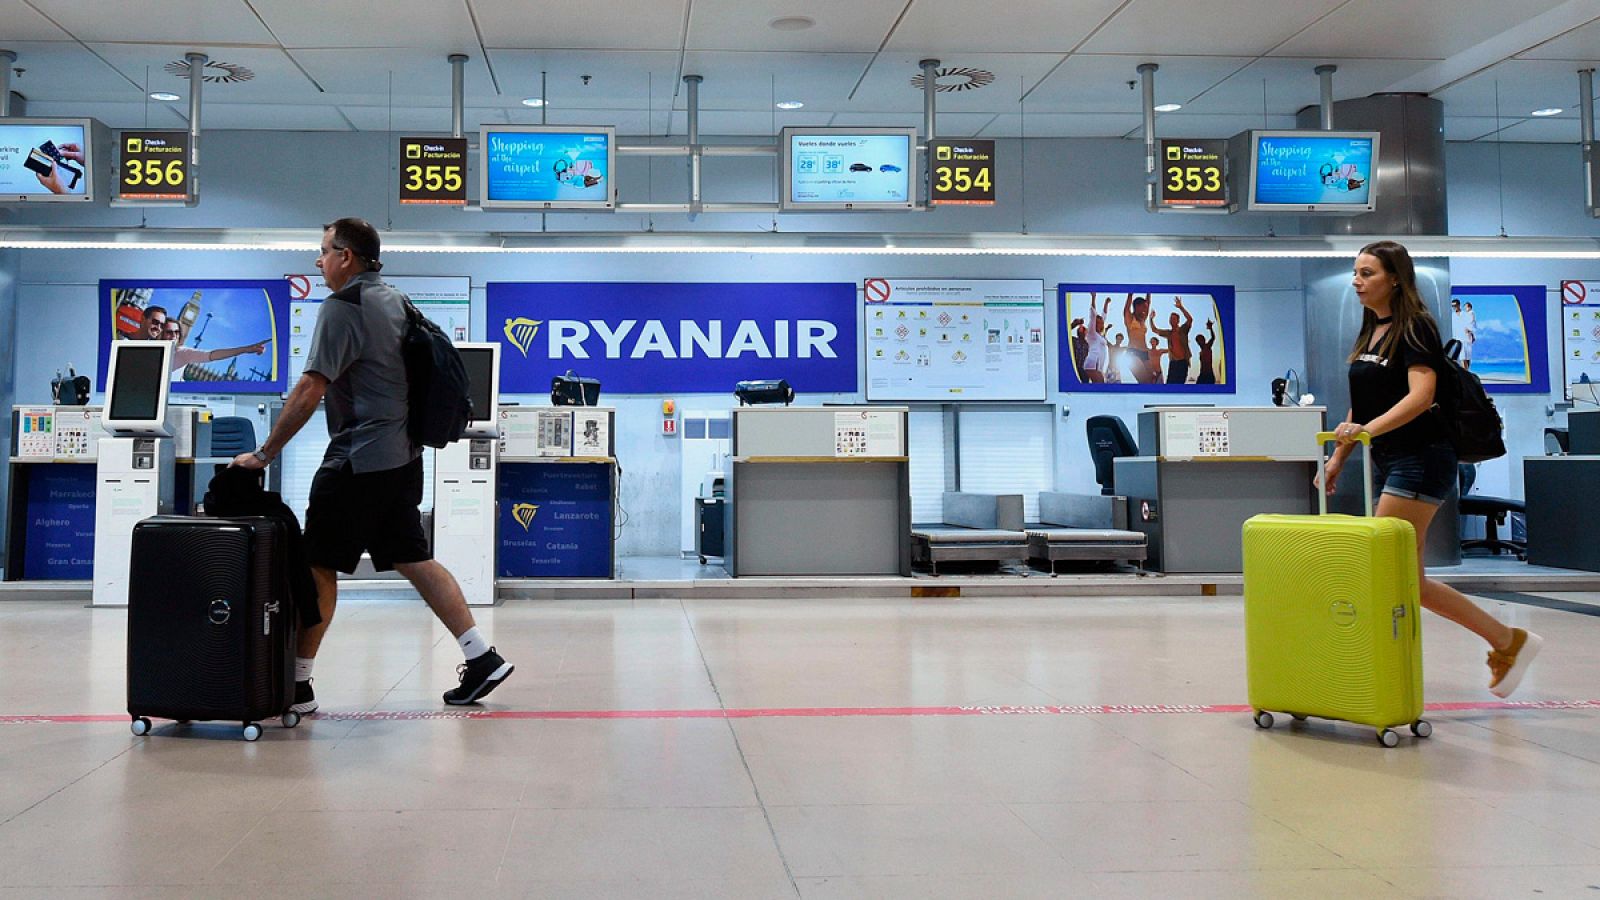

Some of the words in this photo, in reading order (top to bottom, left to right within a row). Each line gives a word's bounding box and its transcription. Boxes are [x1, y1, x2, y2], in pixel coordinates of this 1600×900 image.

[491, 137, 544, 155] Shopping
[1262, 142, 1312, 159] Shopping
[125, 159, 184, 186] 356
[503, 160, 540, 176] airport
[1271, 163, 1307, 180] airport
[405, 165, 462, 191] 355
[936, 167, 991, 192] 354
[1167, 167, 1221, 192] 353
[548, 320, 838, 359] RYANAIR
[36, 519, 70, 527] Alghero
[554, 512, 599, 520] Lanzarote
[546, 542, 578, 550] Catania
